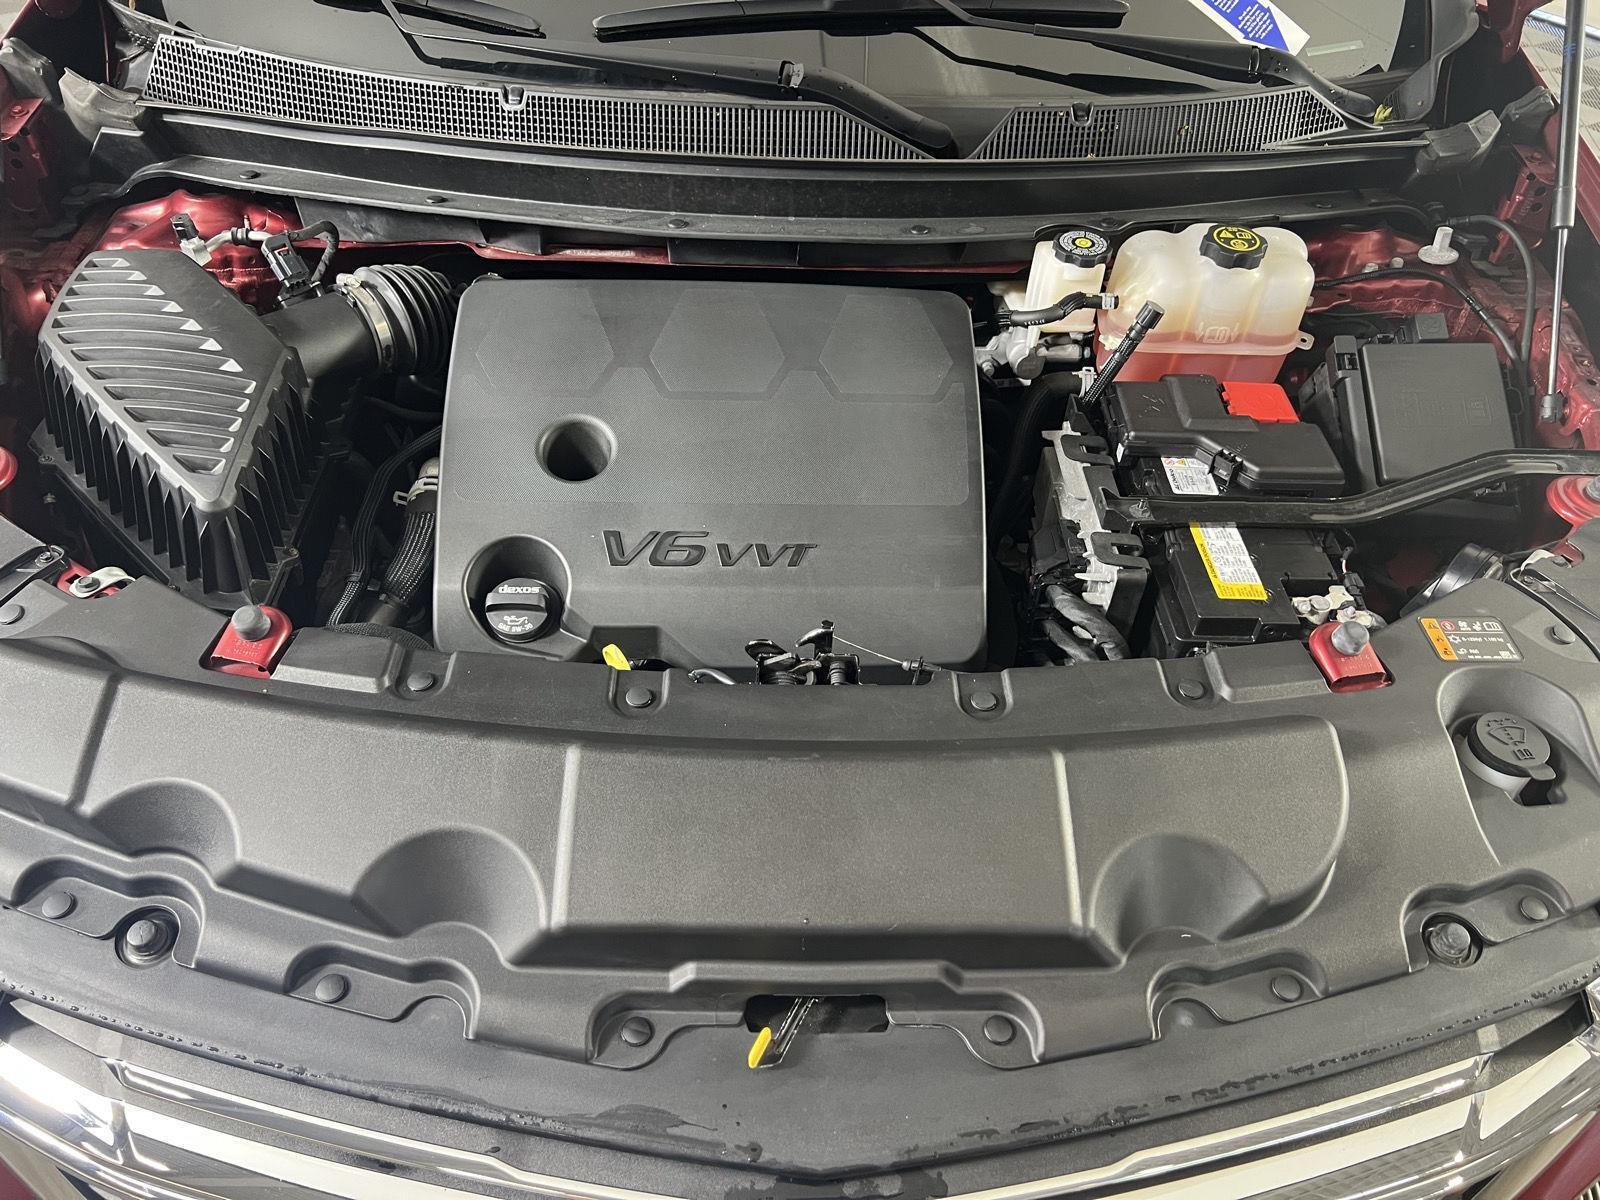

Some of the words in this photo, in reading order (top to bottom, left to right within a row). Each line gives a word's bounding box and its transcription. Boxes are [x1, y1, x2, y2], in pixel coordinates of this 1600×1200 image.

[602, 530, 709, 566] V6
[716, 543, 817, 567] VVT
[498, 584, 541, 594] dexos
